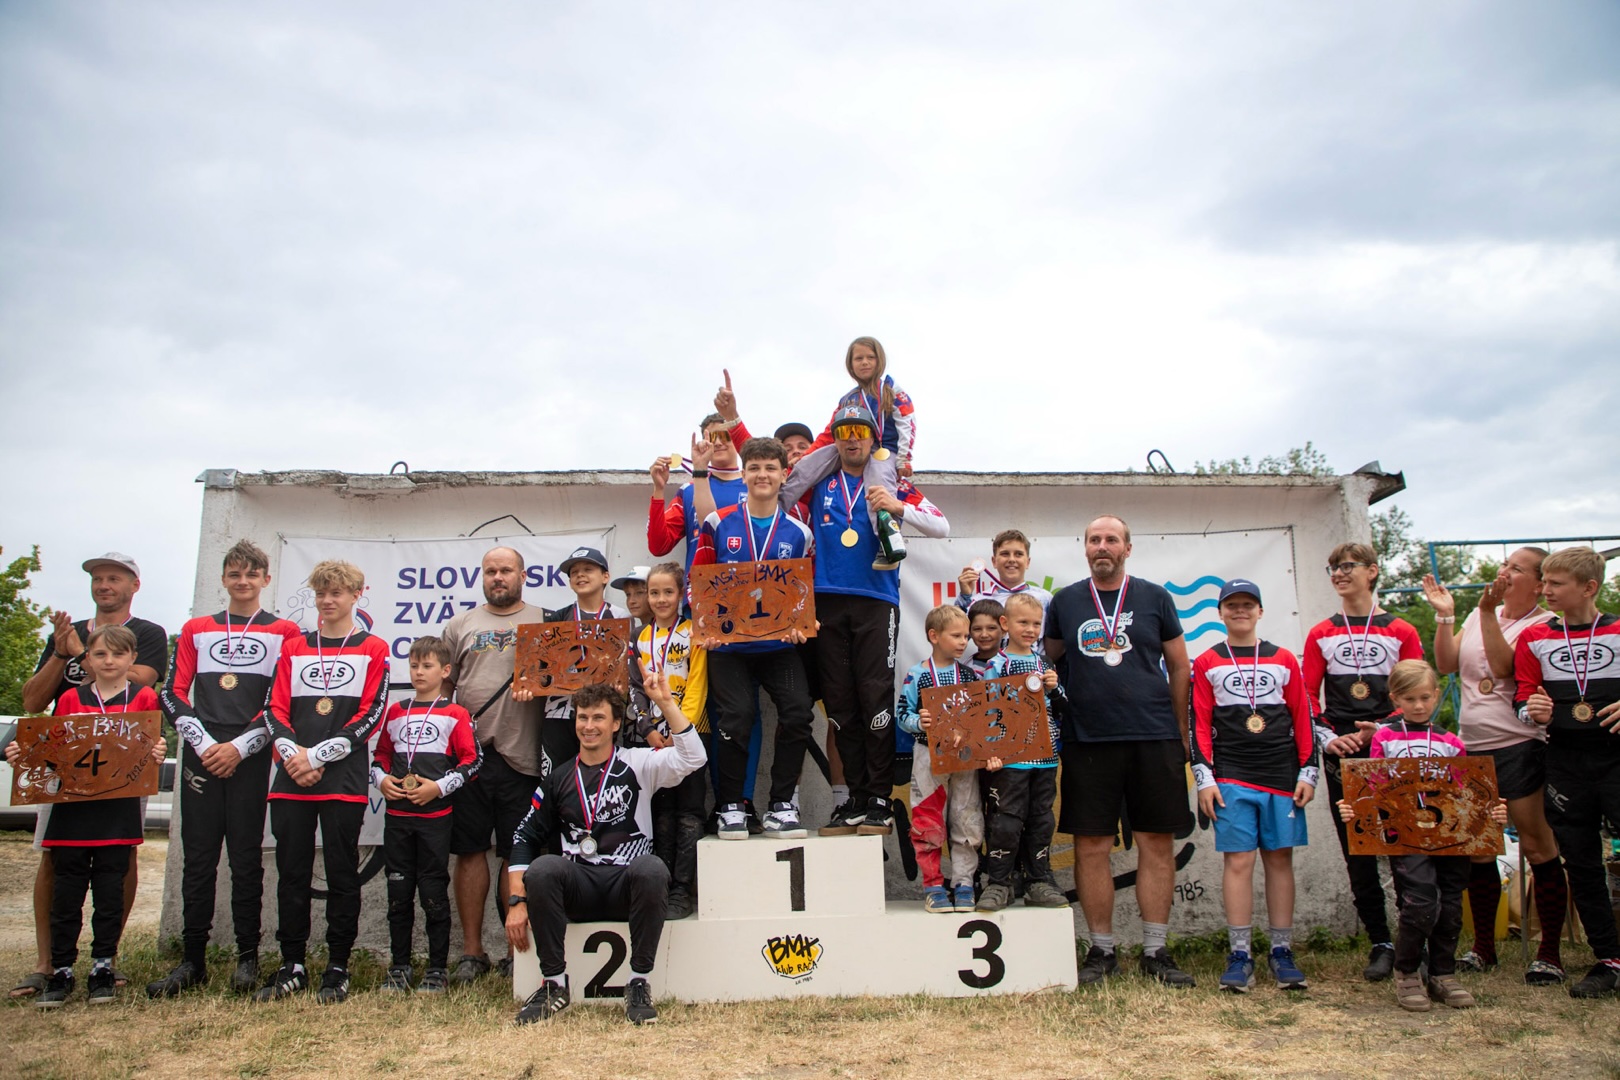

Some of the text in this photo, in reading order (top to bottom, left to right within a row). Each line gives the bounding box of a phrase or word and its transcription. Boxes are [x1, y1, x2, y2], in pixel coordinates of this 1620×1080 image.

[397, 565, 567, 590] SLOVSK
[748, 587, 771, 619] 1
[219, 643, 259, 656] B.R.S
[566, 644, 590, 674] 2
[1232, 675, 1268, 687] B.R.S
[984, 707, 1008, 742] 3
[73, 742, 108, 777] 4
[1416, 790, 1444, 829] 5
[775, 846, 806, 912] 1
[1171, 879, 1204, 906] 985
[582, 930, 627, 998] 2
[767, 933, 820, 965] BMX
[957, 919, 1006, 989] 3
